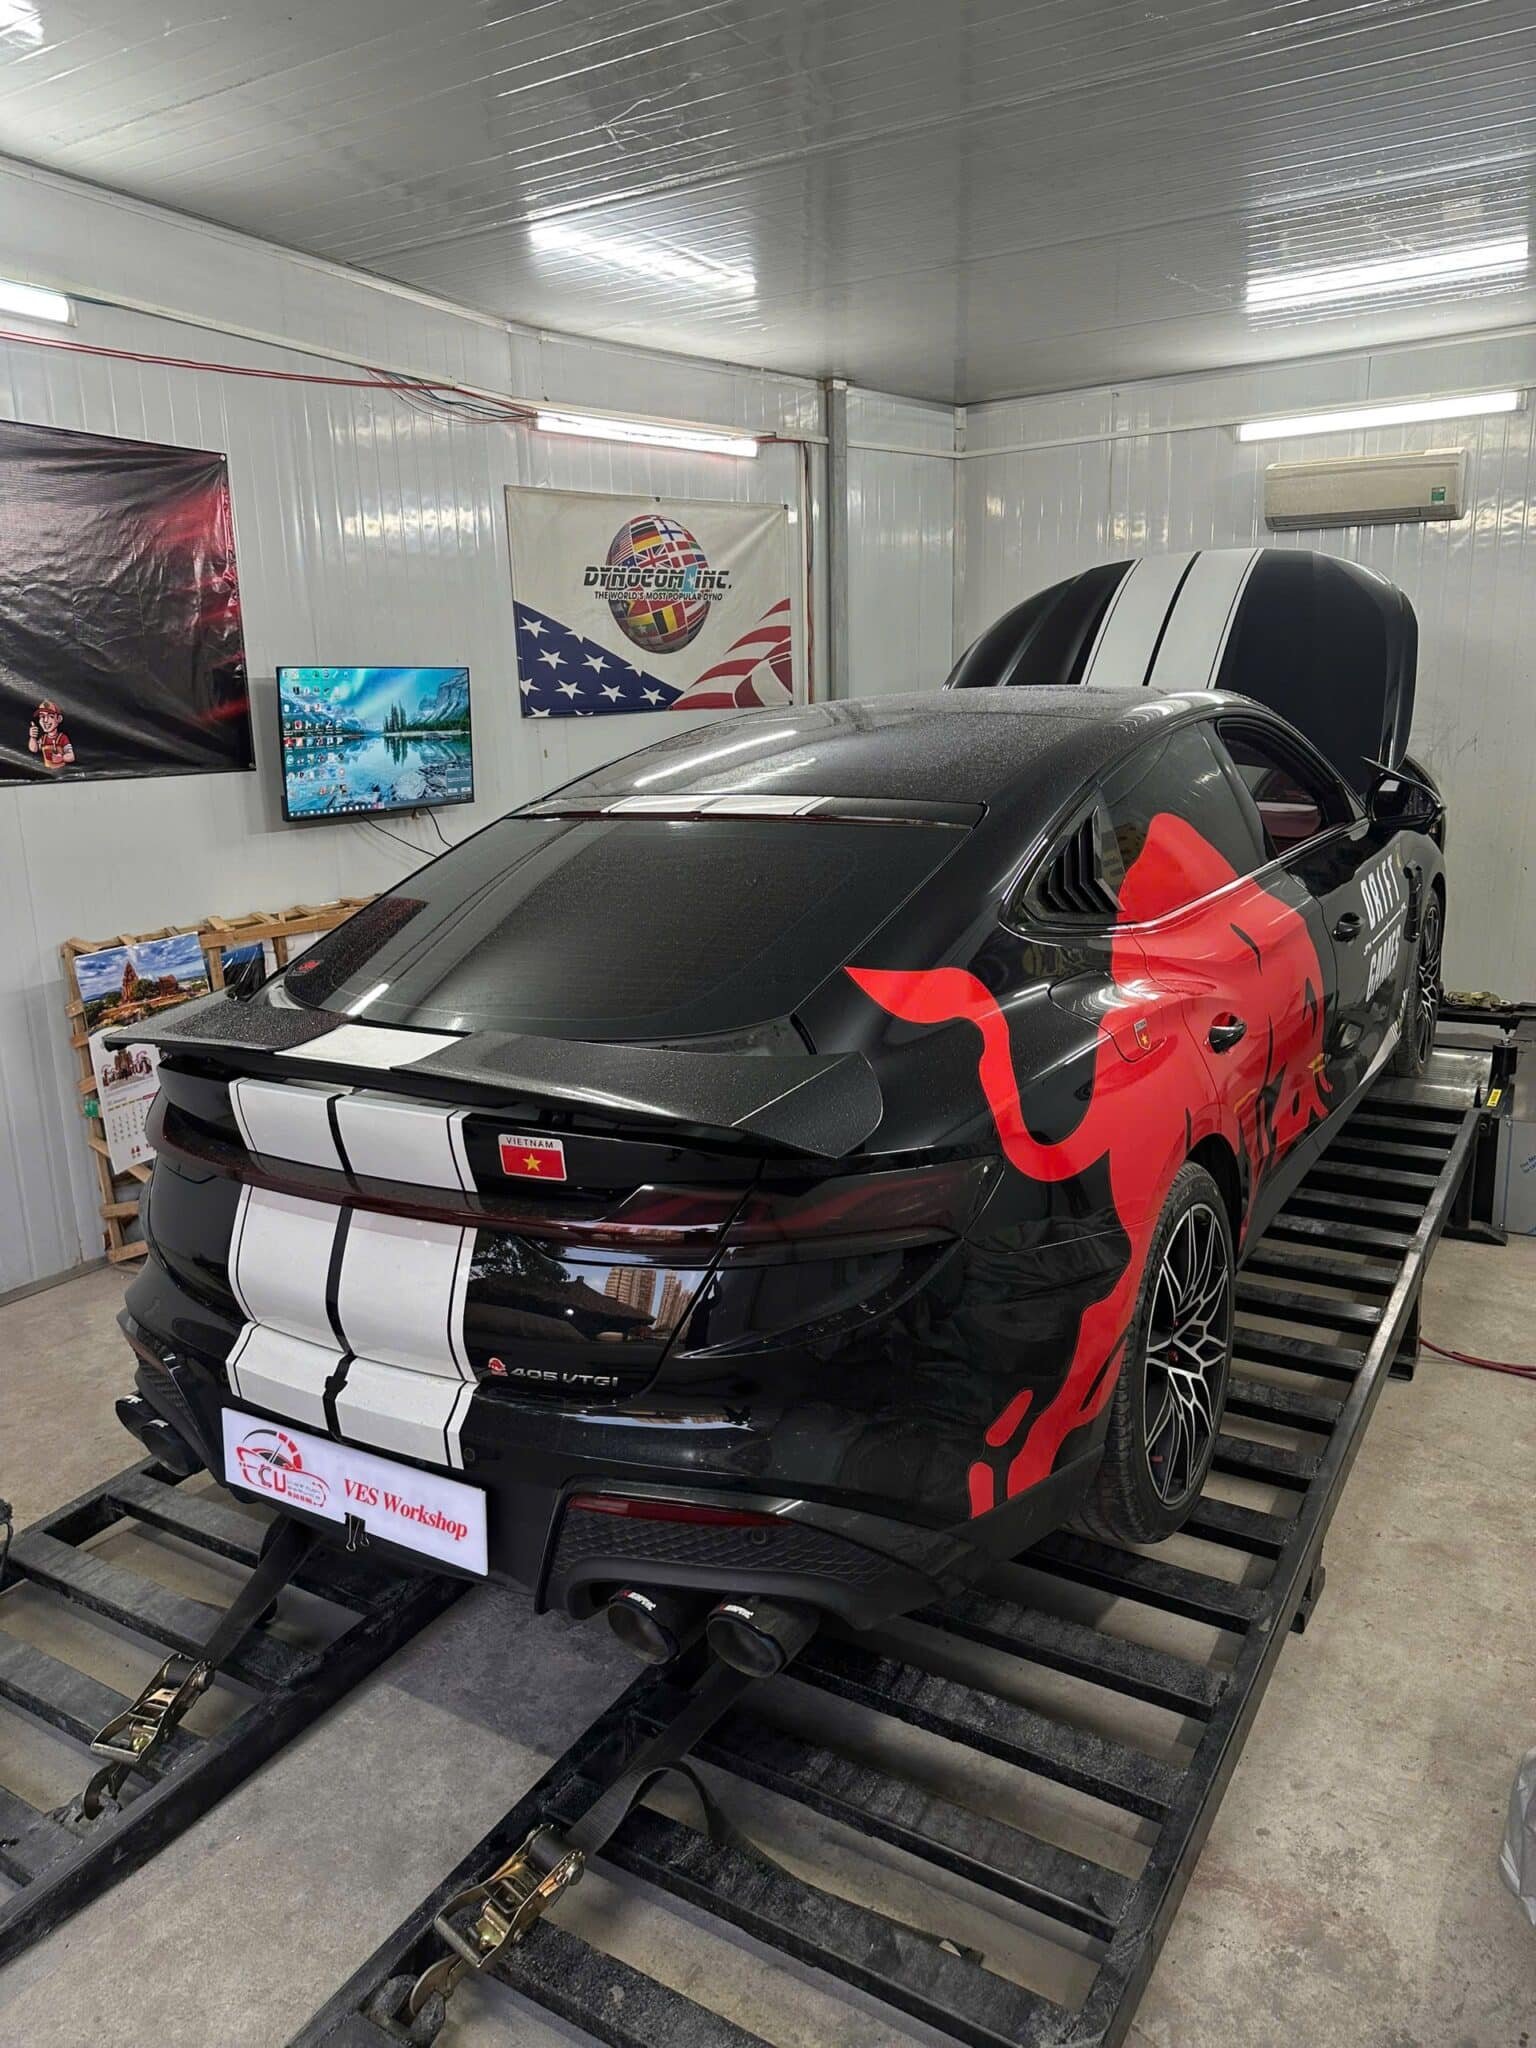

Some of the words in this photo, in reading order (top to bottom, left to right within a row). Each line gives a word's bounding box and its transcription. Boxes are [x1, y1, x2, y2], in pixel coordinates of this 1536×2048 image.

[583, 566, 686, 590] DYNOCOM
[694, 570, 733, 590] INC.
[594, 591, 609, 600] THE
[610, 591, 644, 601] WORLD'S
[645, 592, 667, 601] MOST
[668, 592, 701, 601] POPULAR
[703, 591, 723, 601] DYNO
[1360, 854, 1400, 931] DRIFT
[1365, 924, 1401, 1003] GAMES
[505, 1136, 554, 1149] VIETNAM
[343, 1479, 379, 1506] VES
[383, 1491, 468, 1541] Workshop
